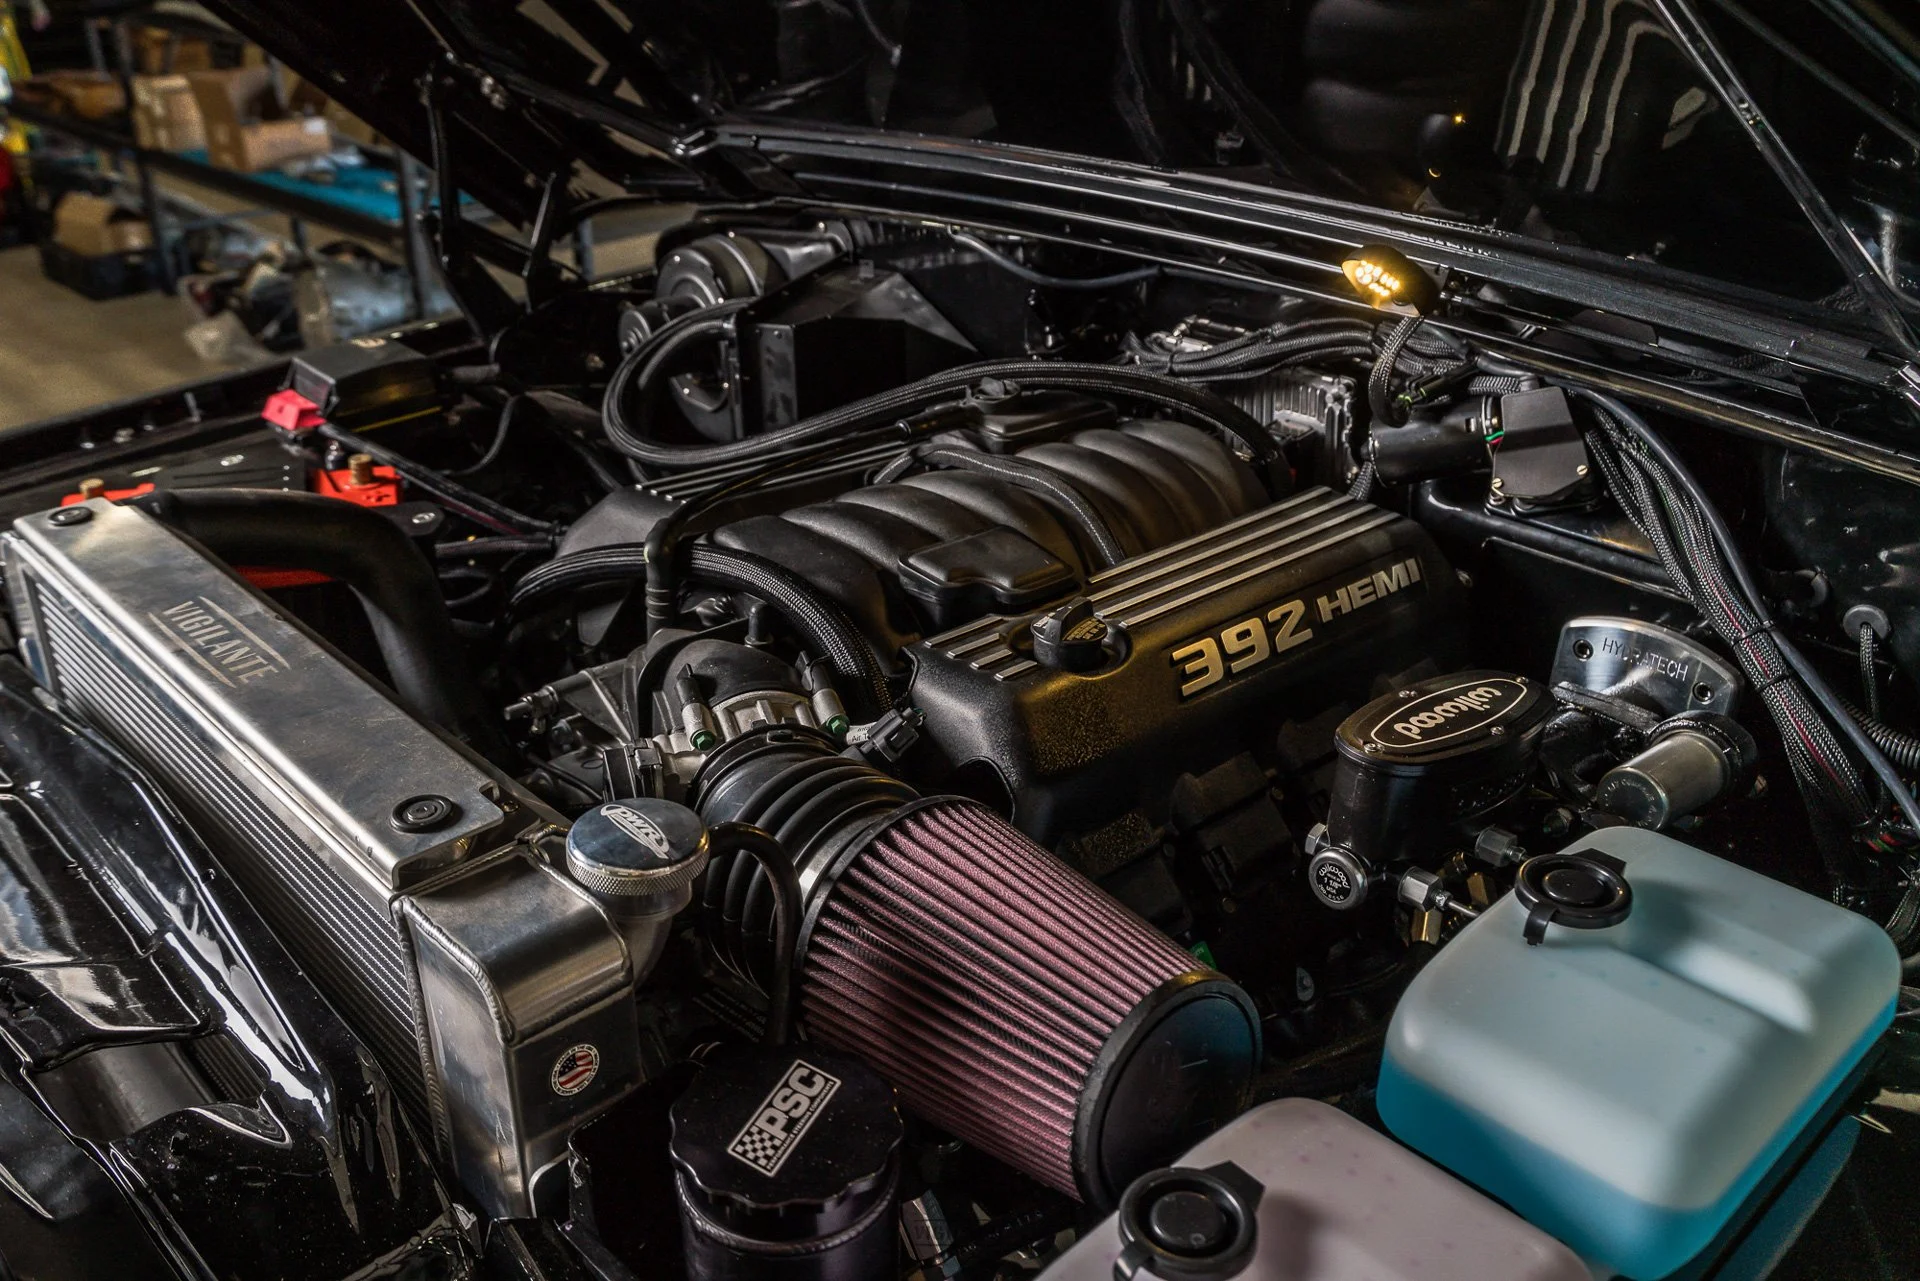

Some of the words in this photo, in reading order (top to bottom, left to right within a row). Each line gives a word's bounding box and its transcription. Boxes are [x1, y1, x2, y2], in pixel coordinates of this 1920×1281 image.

[162, 600, 279, 684] VIGILANTE
[1172, 599, 1314, 697] 392
[1316, 558, 1421, 623] HEMI
[1393, 686, 1502, 740] wilwood
[603, 806, 669, 857] PWR
[1319, 863, 1351, 889] wilwood
[754, 1067, 826, 1141] PSC
